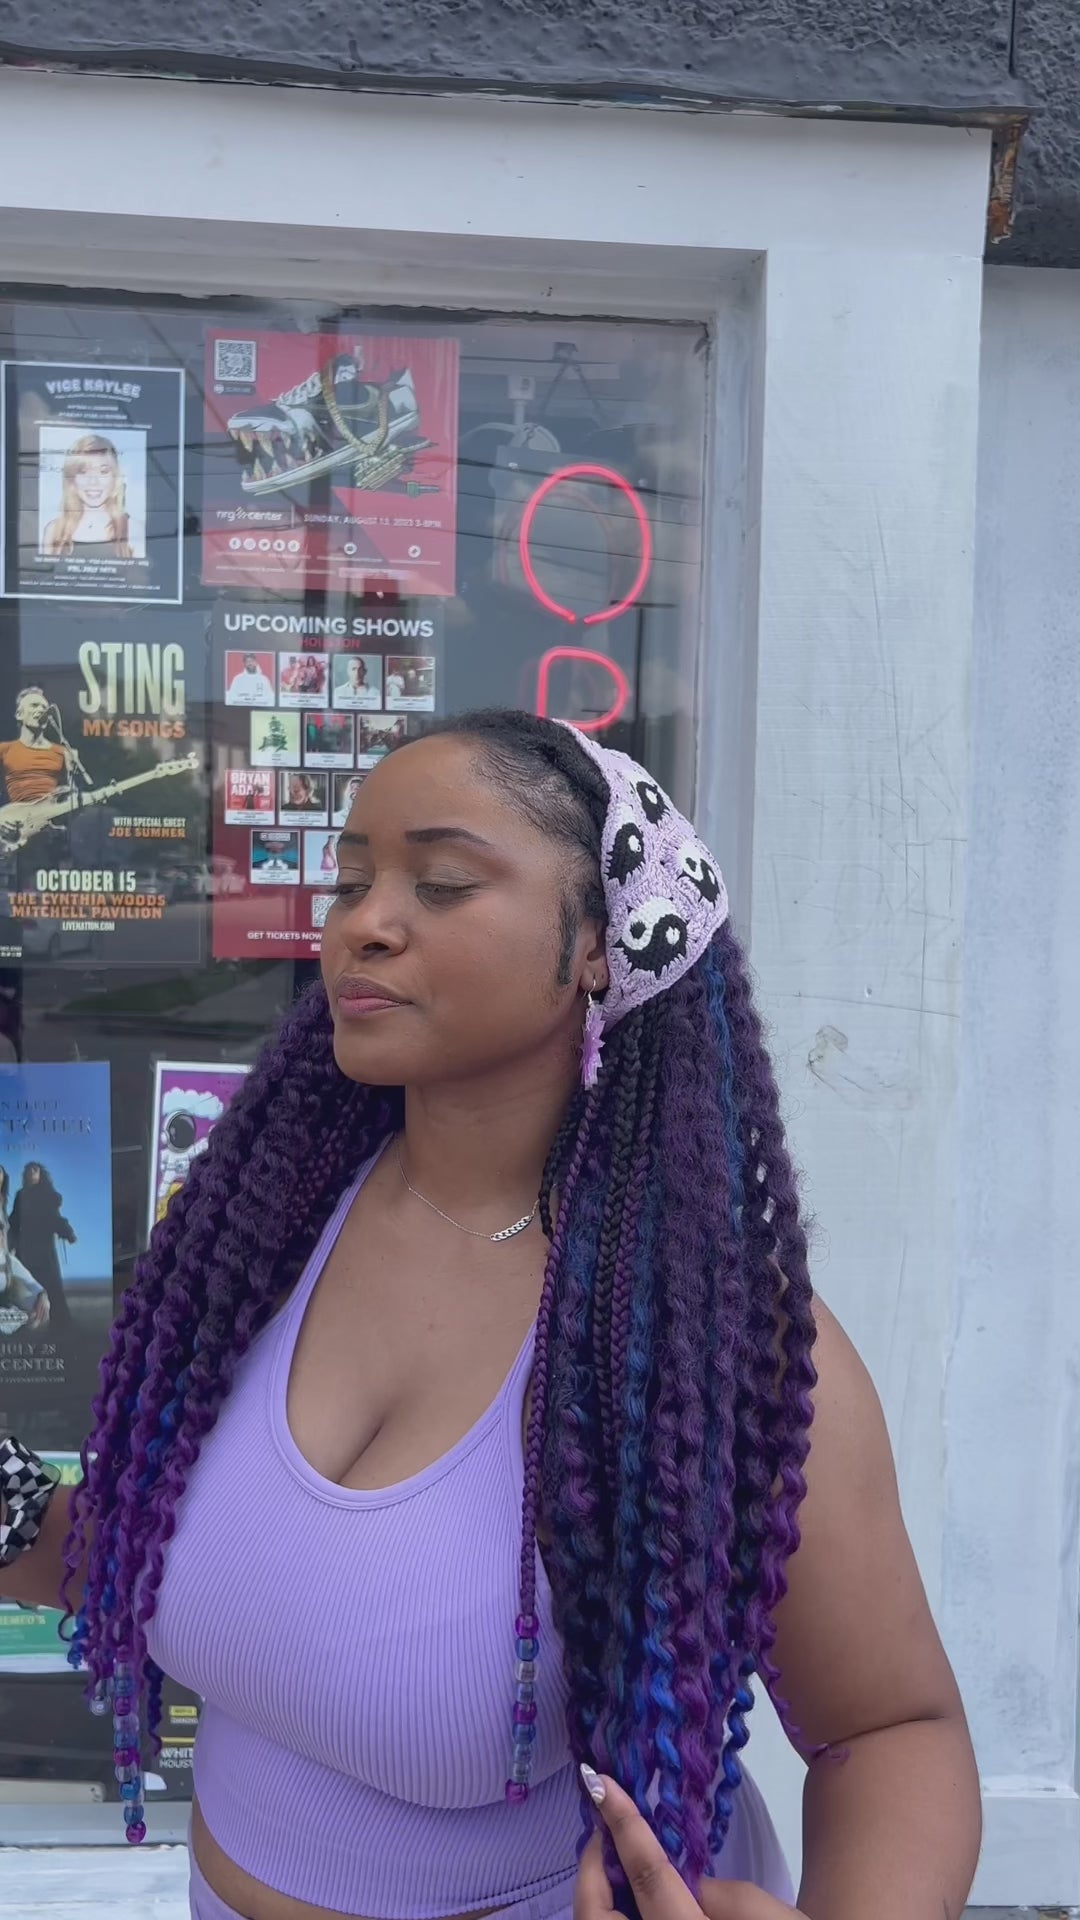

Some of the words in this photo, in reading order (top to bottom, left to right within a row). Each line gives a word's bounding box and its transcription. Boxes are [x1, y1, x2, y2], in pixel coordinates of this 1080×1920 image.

[83, 379, 141, 398] KAYLEE
[216, 510, 235, 522] nrg
[248, 511, 282, 521] center
[343, 514, 377, 525] AUGUST
[224, 614, 347, 635] UPCOMING
[352, 618, 434, 637] SHOWS
[298, 636, 360, 648] HOUSTON
[78, 641, 186, 715] STING
[83, 719, 114, 737] MY
[117, 720, 186, 738] SONGS
[231, 772, 270, 785] BRYAN
[231, 785, 270, 796] ADAS
[113, 817, 133, 827] WITH
[133, 817, 162, 827] SPECIAL
[163, 818, 186, 828] GUEST
[109, 828, 132, 837] JOE
[135, 828, 186, 838] SUMNER
[36, 870, 115, 892] OCTOBER
[119, 870, 137, 892] 15
[8, 892, 37, 905] THE
[42, 893, 106, 906] CYNTHIA
[111, 894, 166, 906] WOODS
[11, 905, 87, 919] MITCHELL
[92, 905, 163, 919] PAVILION
[62, 921, 115, 931] LIVENATION.COM
[247, 931, 264, 940] GET
[266, 931, 300, 940] TICKETS
[0, 1358, 65, 1370] CENTER
